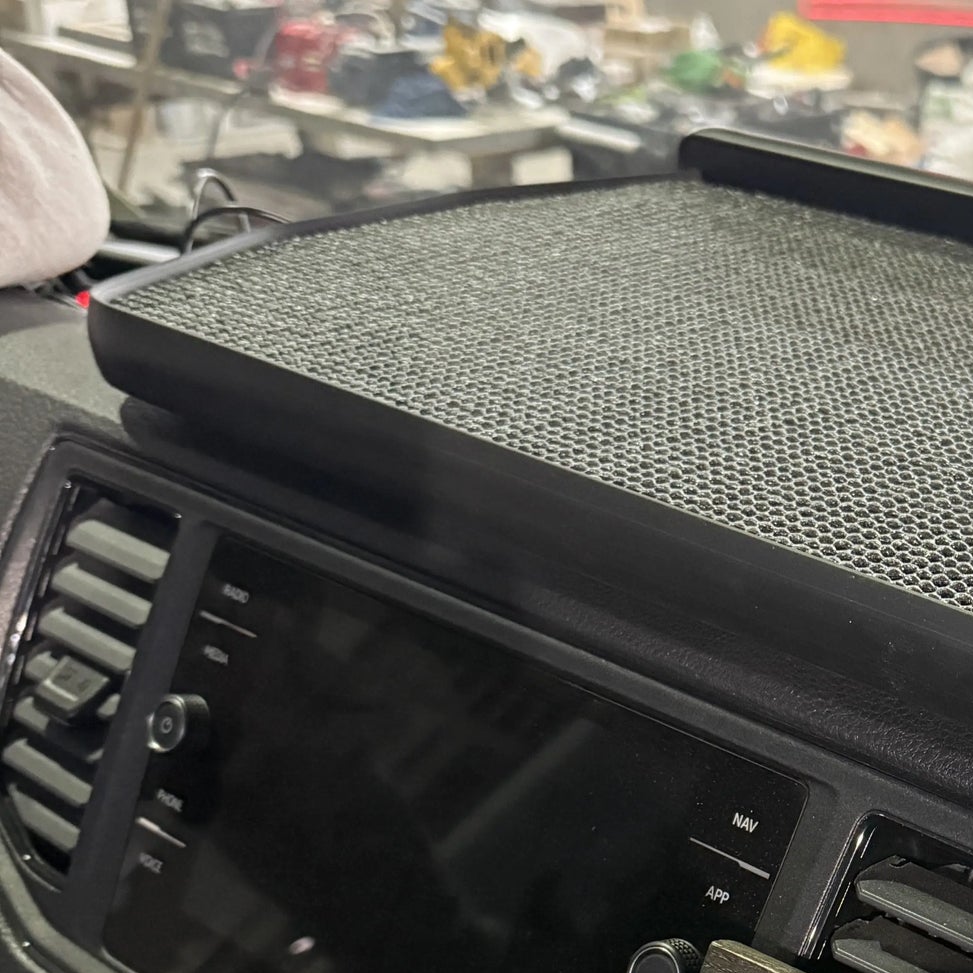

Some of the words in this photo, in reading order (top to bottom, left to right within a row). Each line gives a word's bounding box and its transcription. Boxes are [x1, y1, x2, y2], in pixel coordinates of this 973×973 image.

[223, 583, 250, 603] RADIO
[157, 789, 183, 812] PHONE
[732, 812, 759, 833] NAV
[140, 852, 163, 874] VOICE
[705, 885, 730, 905] APP
